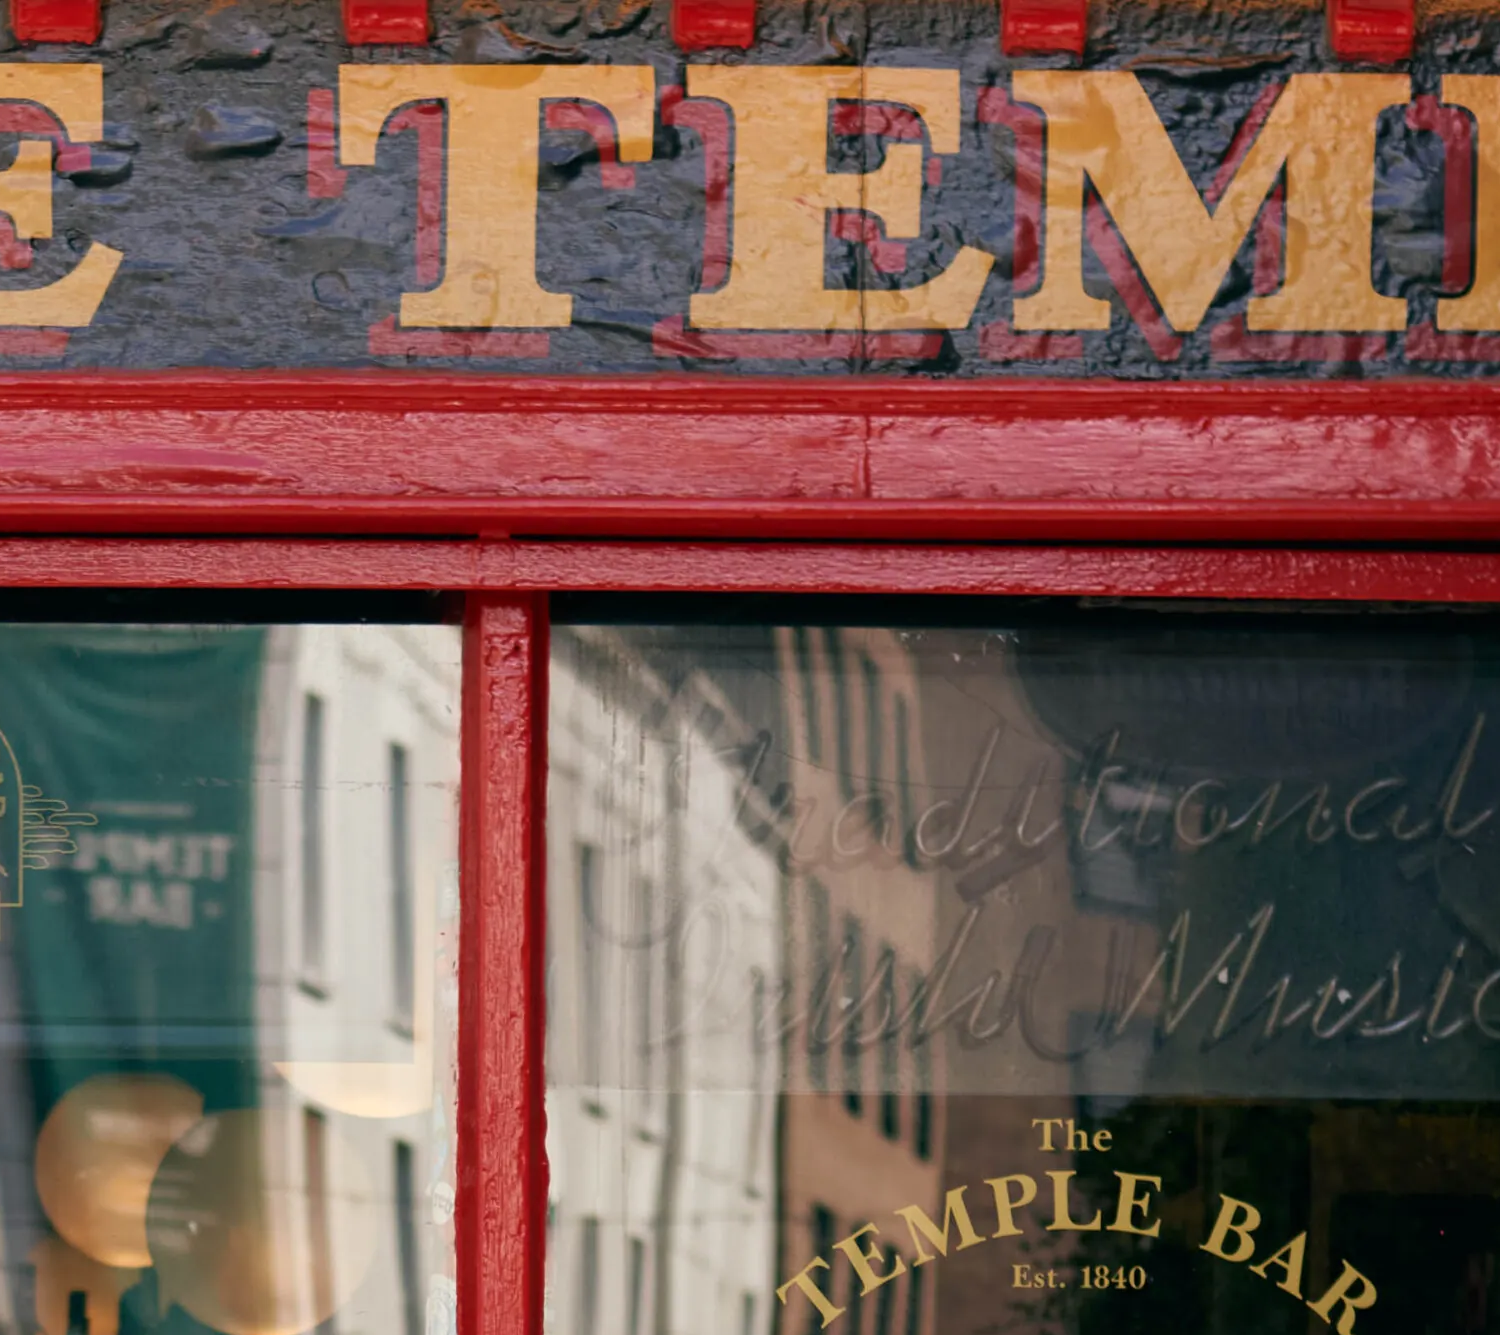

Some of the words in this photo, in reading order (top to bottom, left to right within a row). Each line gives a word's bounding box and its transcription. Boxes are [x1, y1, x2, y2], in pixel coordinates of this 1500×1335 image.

[1032, 1118, 1112, 1152] The
[776, 1169, 1163, 1329] TEMPLE
[1012, 1264, 1066, 1289] Est.
[1080, 1264, 1146, 1289] 1840
